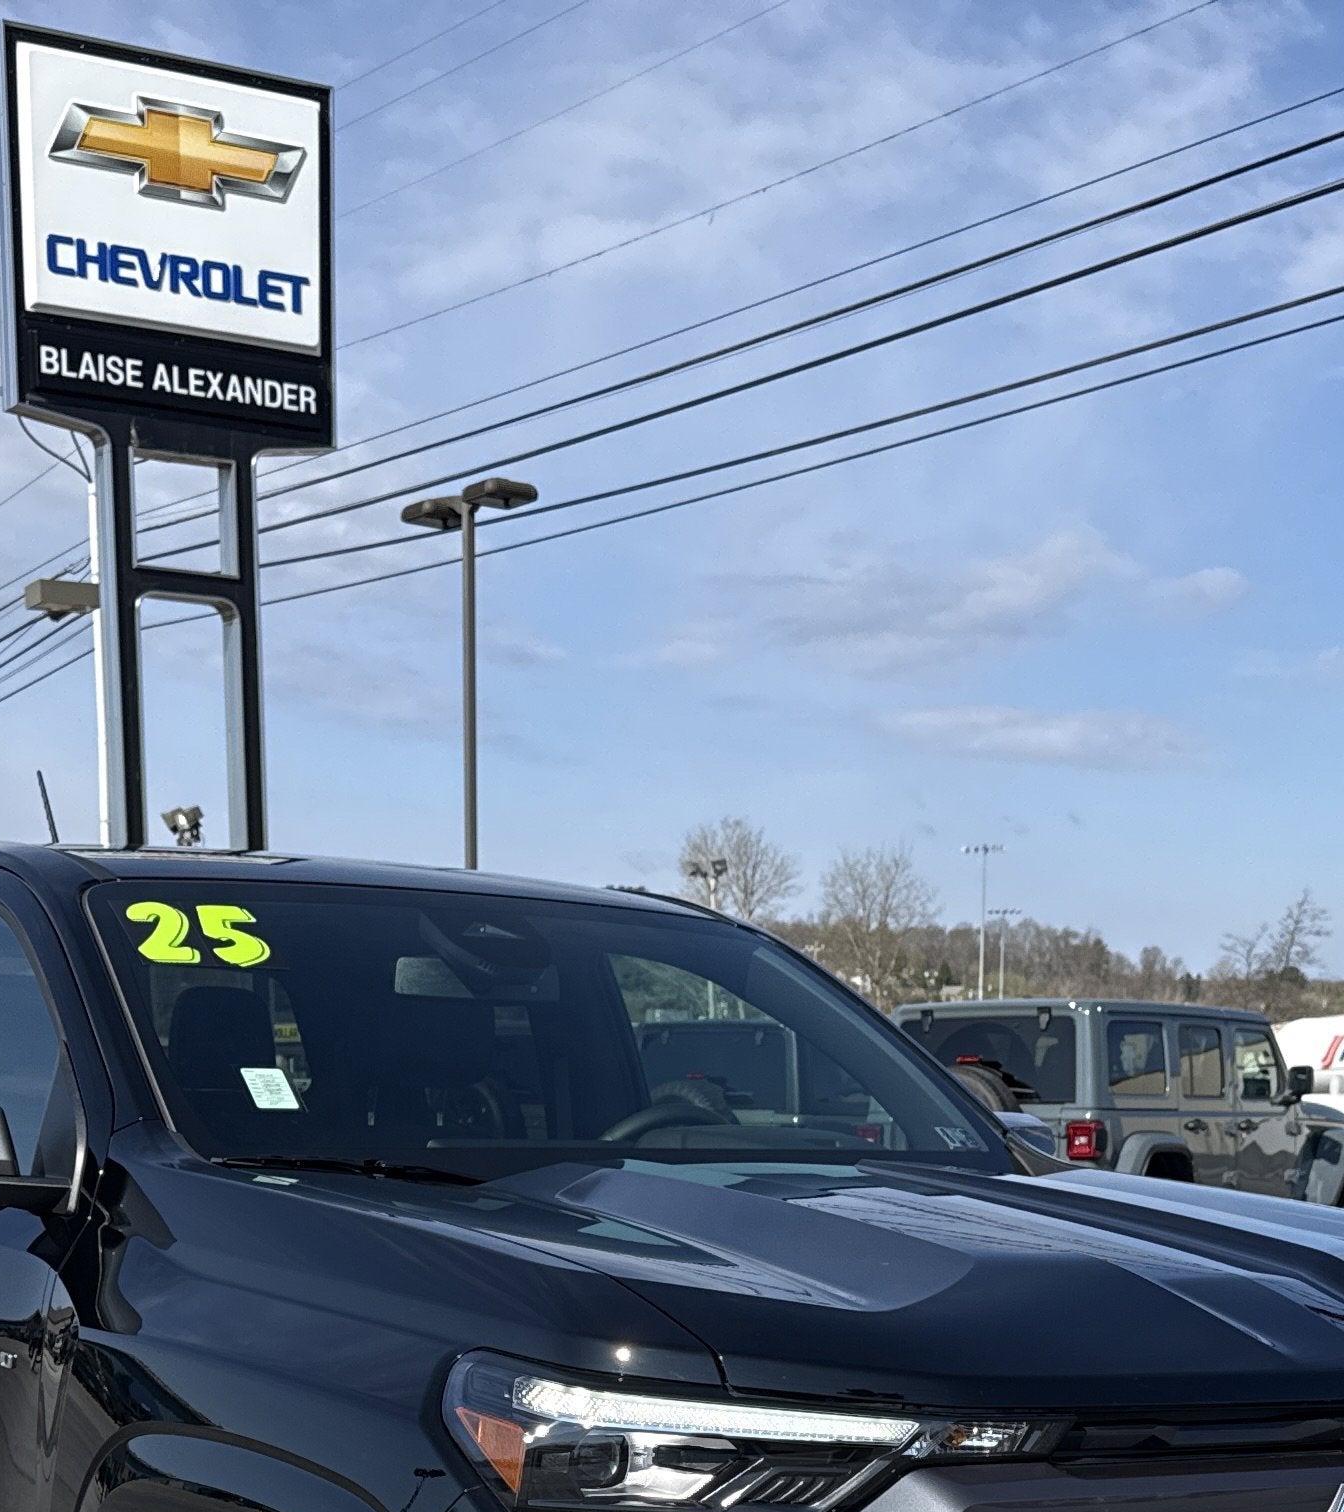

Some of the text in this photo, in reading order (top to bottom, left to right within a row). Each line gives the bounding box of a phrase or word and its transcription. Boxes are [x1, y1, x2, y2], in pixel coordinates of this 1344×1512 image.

[46, 233, 310, 314] CHEVROLET
[40, 345, 317, 415] BLAISE ALEXANDER
[126, 901, 271, 967] 25
